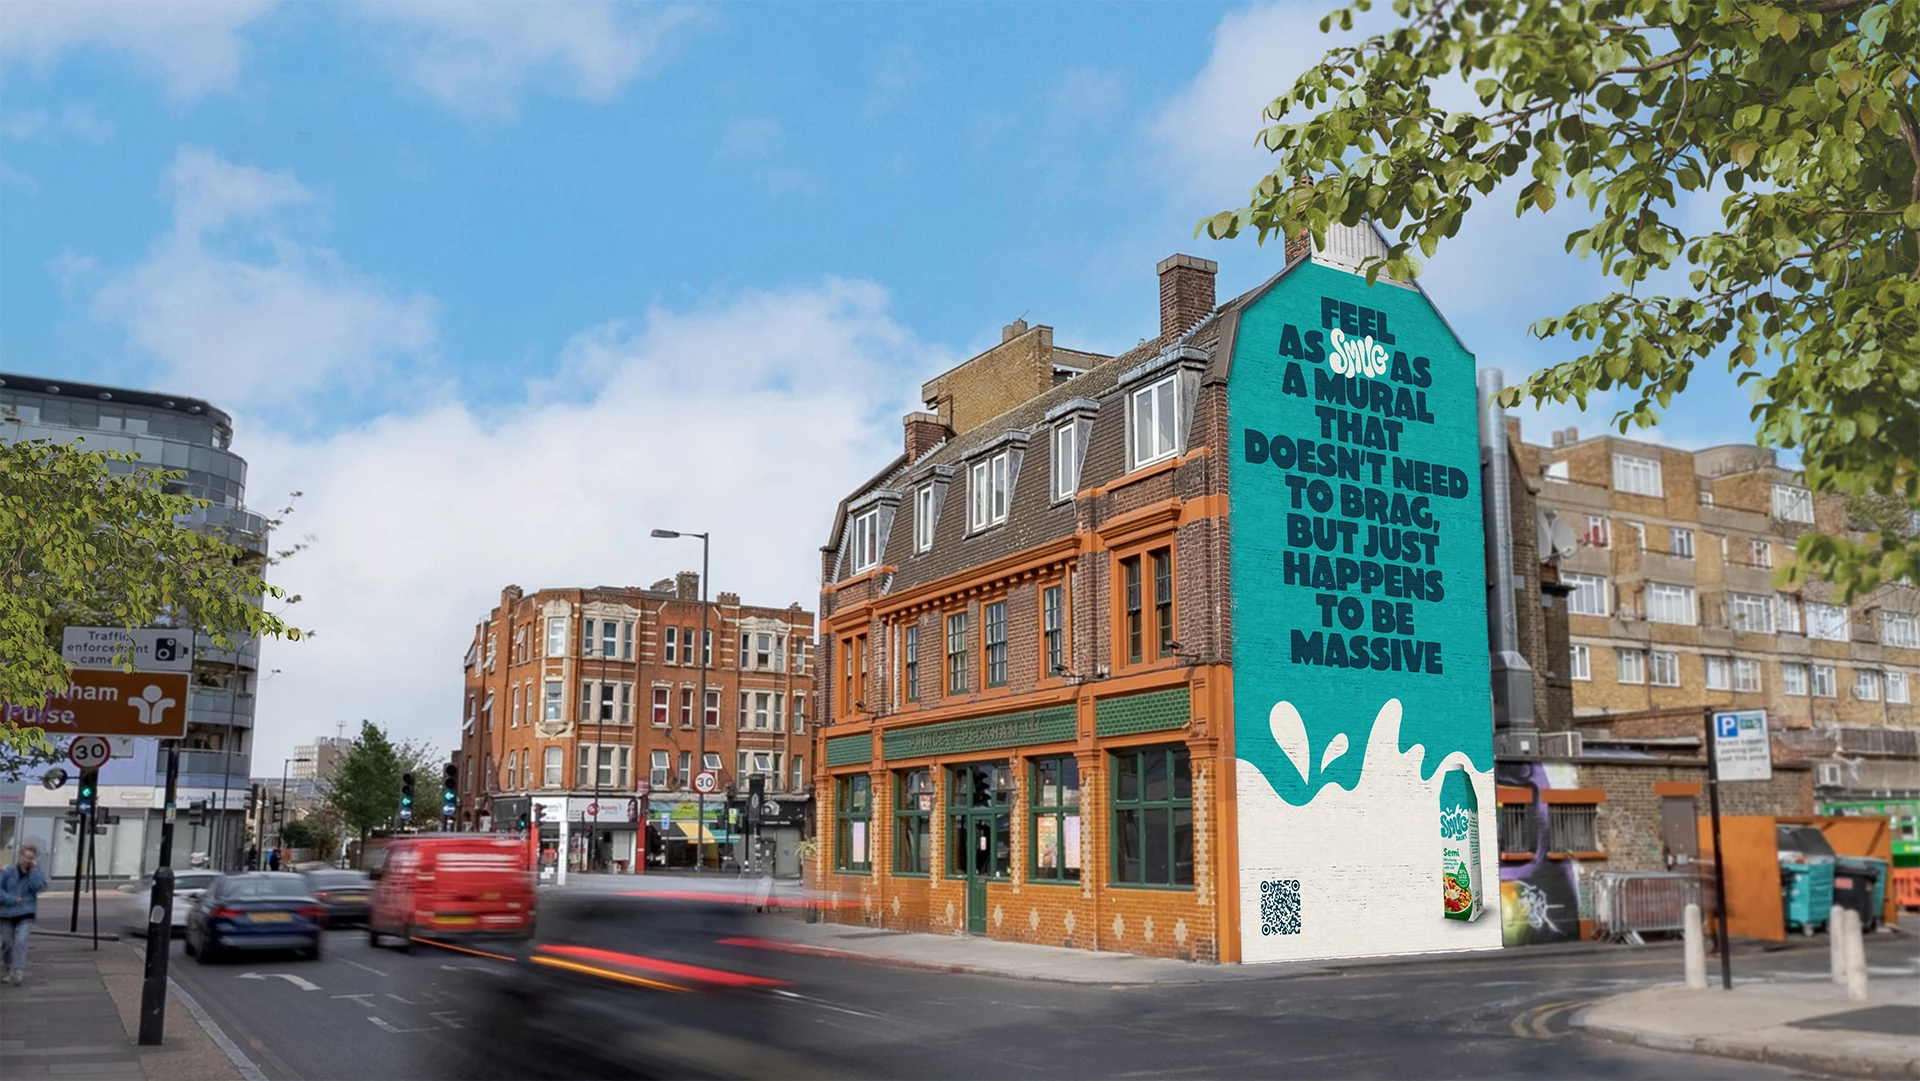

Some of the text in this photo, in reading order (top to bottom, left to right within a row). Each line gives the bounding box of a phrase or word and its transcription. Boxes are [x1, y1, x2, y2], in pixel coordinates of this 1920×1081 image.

[1321, 296, 1396, 345] FEEL
[1278, 323, 1433, 388] AS SMUG AS
[1281, 361, 1435, 424] A MURAL
[1315, 404, 1403, 452] THAT
[1244, 428, 1469, 498] DOESN'T NEED
[1285, 474, 1441, 533] TO BRAG,
[1287, 512, 1440, 565] BUT JUST
[1283, 550, 1445, 602] HAPPENS
[1316, 593, 1415, 635] TO BE
[1290, 629, 1443, 675] MASSIVE
[1721, 717, 1736, 736] P
[75, 743, 105, 760] 30
[697, 777, 714, 788] 30
[1440, 812, 1469, 839] SMUG
[1443, 847, 1460, 857] Semi
